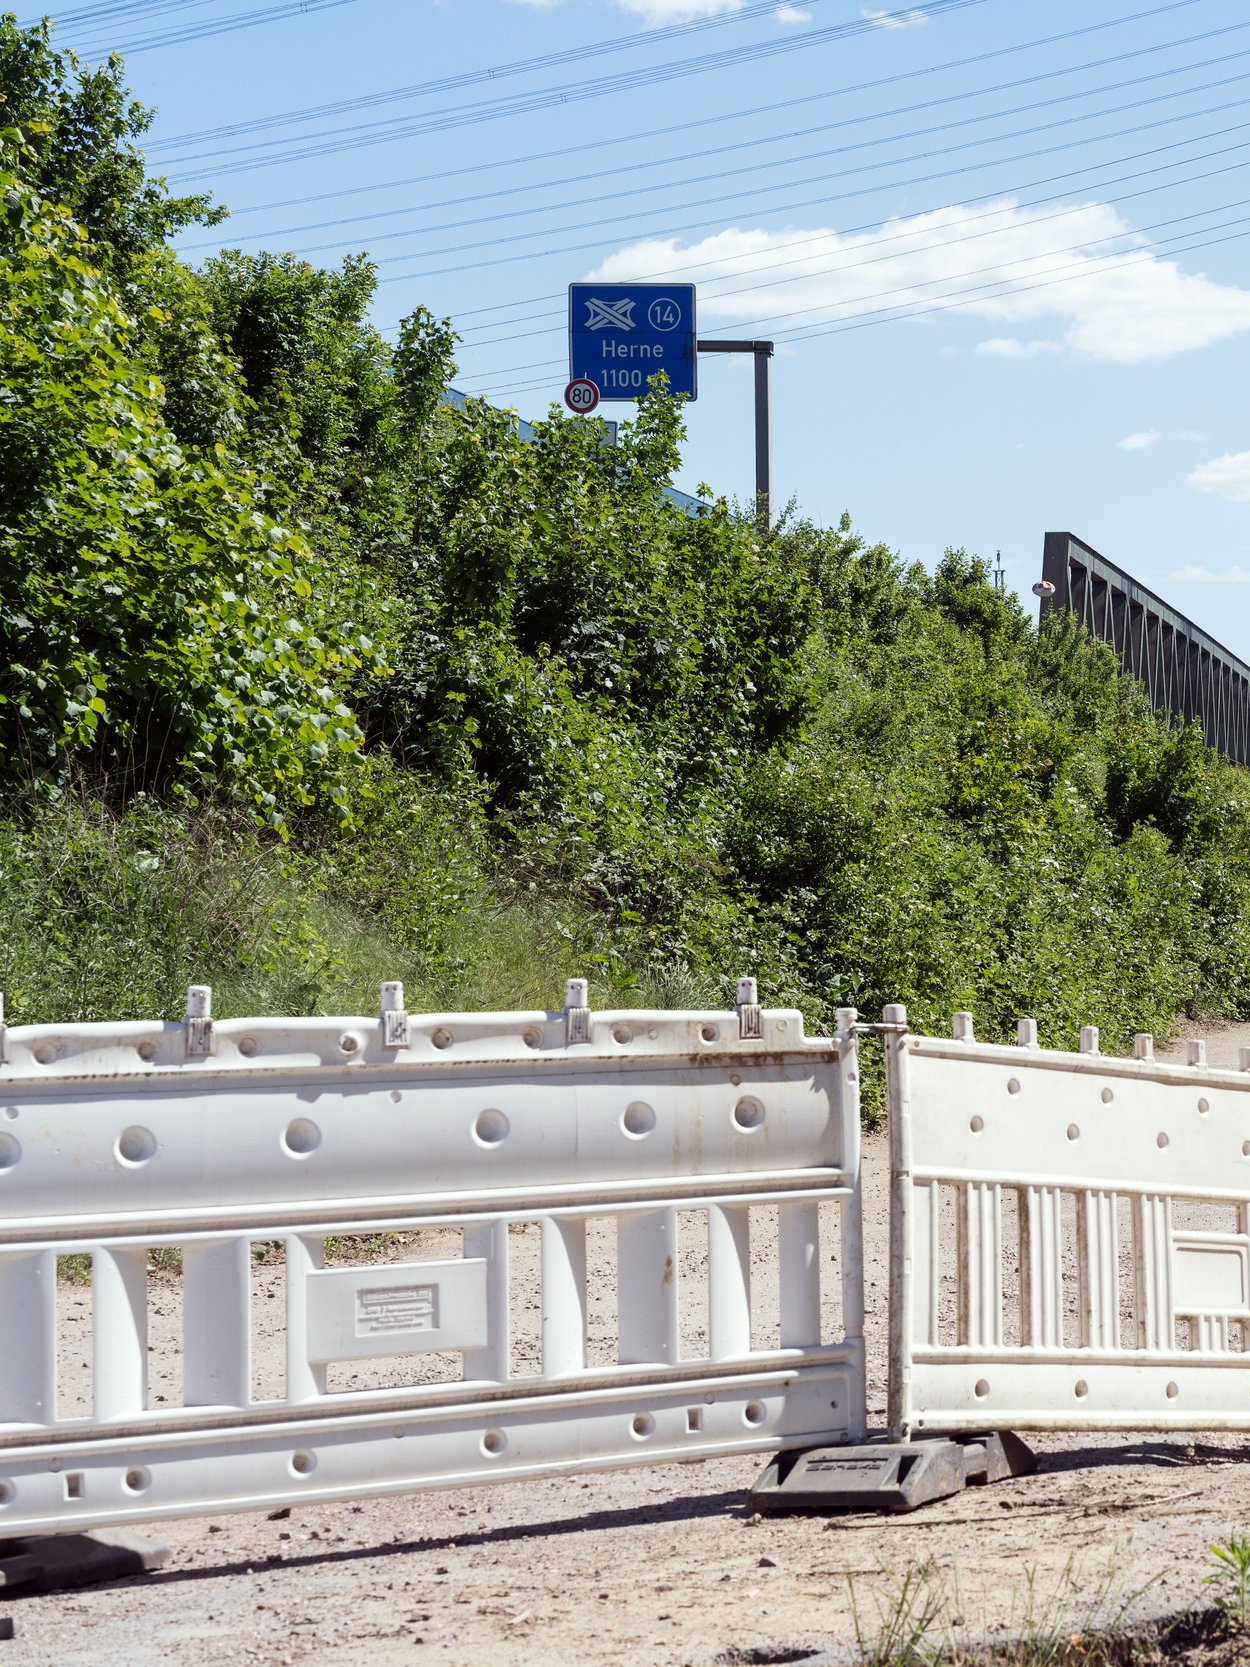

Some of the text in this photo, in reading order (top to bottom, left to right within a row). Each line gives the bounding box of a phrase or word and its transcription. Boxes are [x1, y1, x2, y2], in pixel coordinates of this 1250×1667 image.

[654, 305, 675, 324] 14
[602, 339, 664, 358] Herne
[601, 369, 642, 388] 1100
[572, 387, 592, 404] 80
